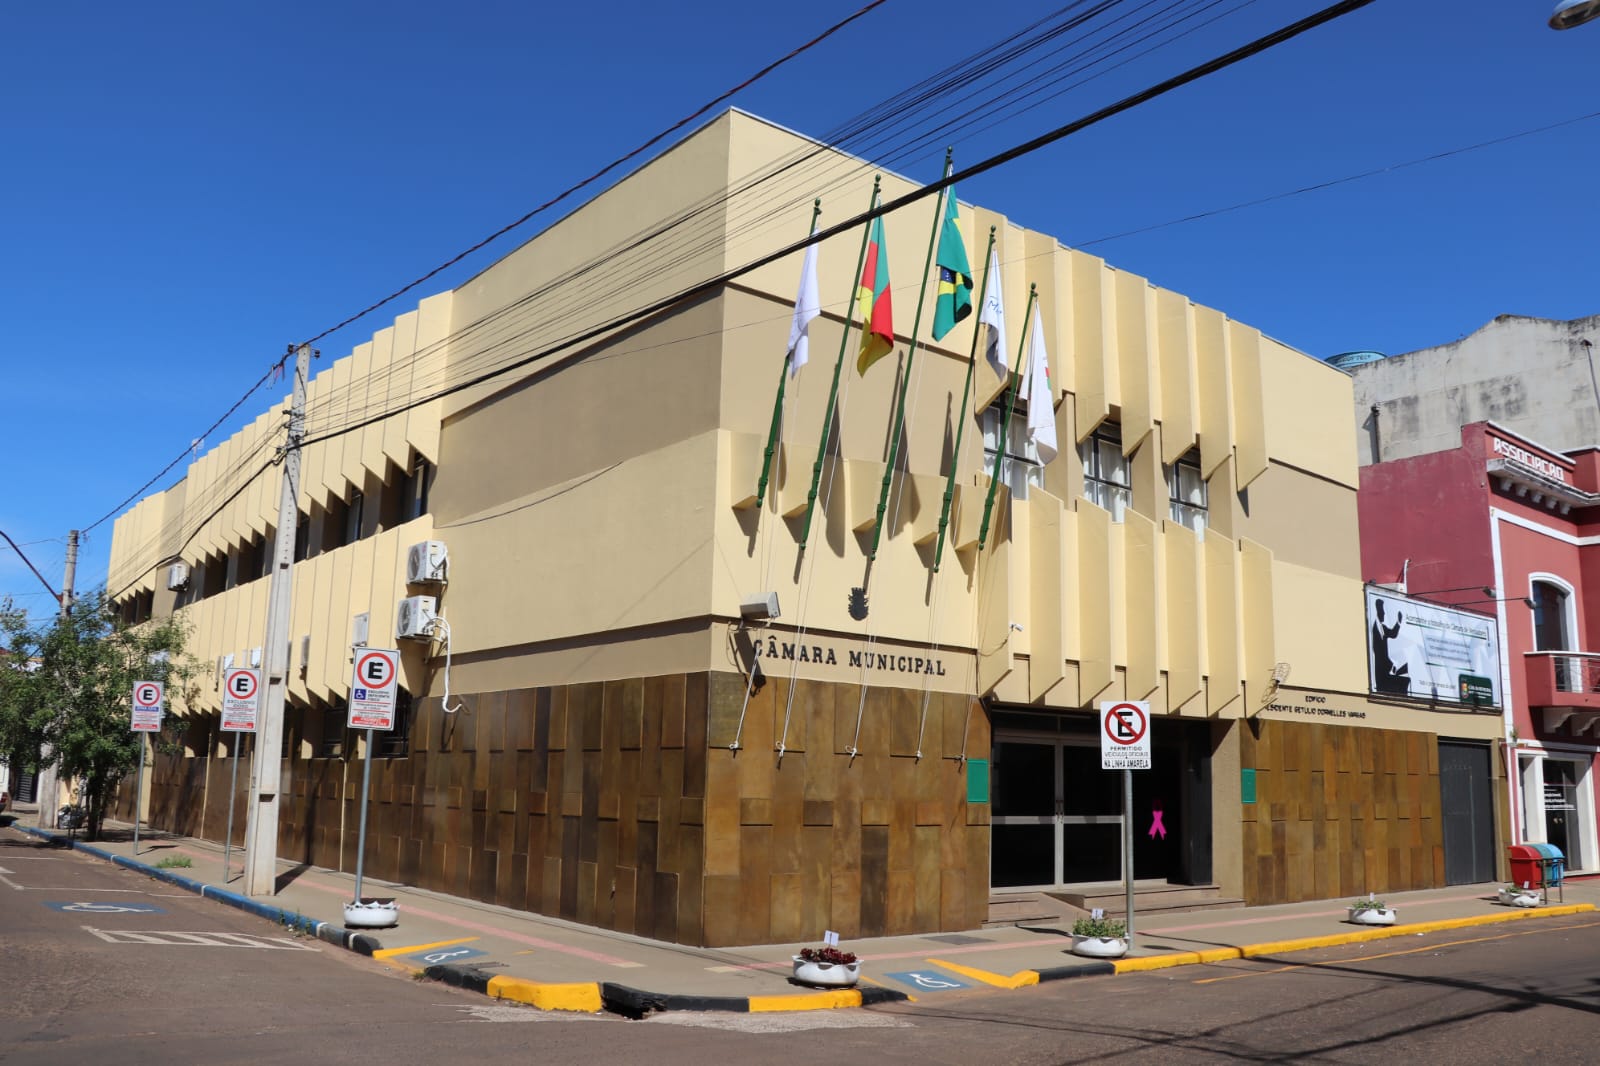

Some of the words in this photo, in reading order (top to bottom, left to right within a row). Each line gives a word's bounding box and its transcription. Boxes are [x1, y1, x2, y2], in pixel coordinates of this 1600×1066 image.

[753, 635, 838, 666] CÂMARA
[848, 650, 946, 676] MUNICIPAL
[367, 662, 384, 680] E
[235, 678, 249, 692] E
[143, 689, 153, 701] E
[1117, 711, 1135, 737] E
[1112, 760, 1126, 768] LINHA
[1127, 760, 1149, 768] AMARELA
